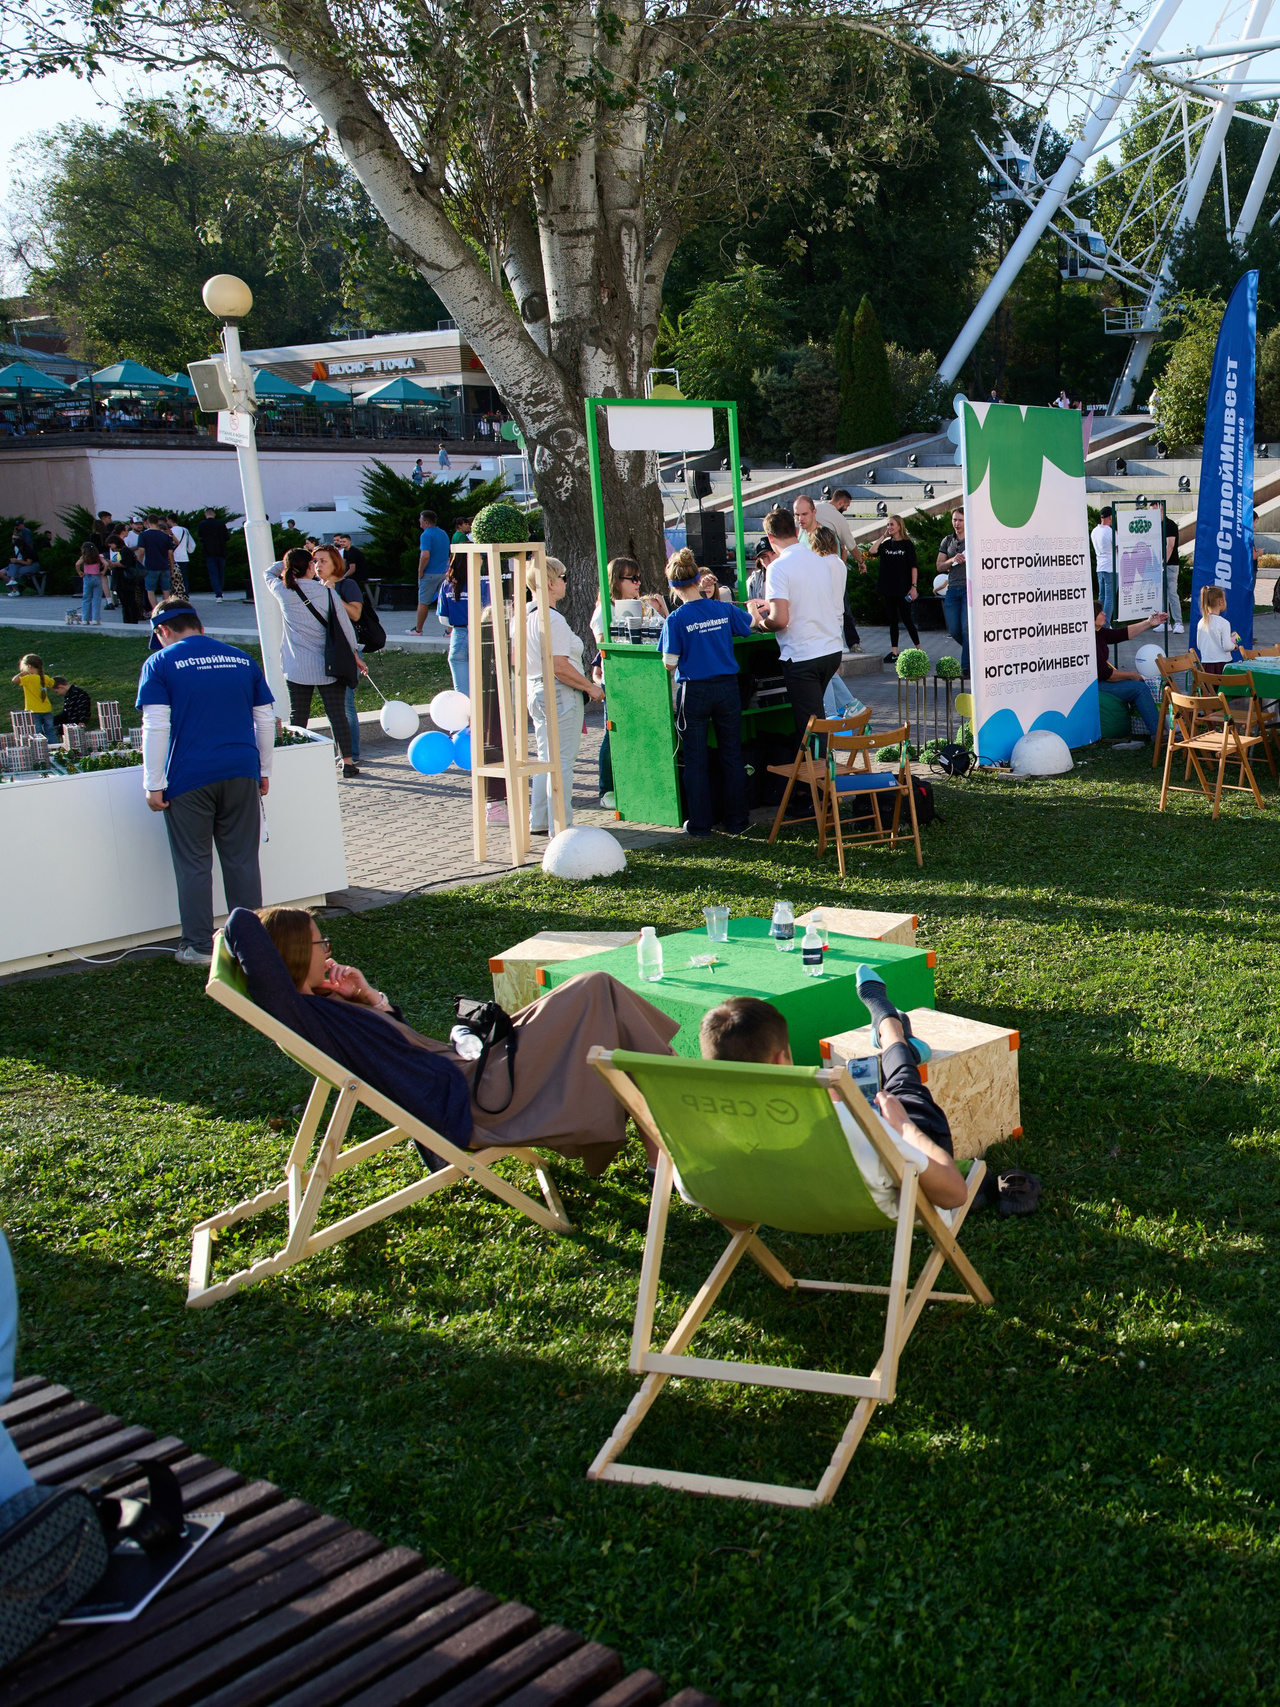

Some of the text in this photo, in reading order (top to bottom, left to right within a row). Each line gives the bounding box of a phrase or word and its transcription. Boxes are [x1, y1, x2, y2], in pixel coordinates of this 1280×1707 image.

[381, 357, 415, 371] ТОЧКА
[1237, 416, 1245, 488] КОМПАНИЙ
[980, 534, 1085, 552] ЮГСТРОЙИНВЕСТ
[981, 552, 1085, 570] ЮГСТРОЙИНВЕСТ
[982, 569, 1087, 589] ЮГСТРОЙИНВЕСТ
[982, 588, 1087, 606] ЮГСТРОЙИНВЕСТ
[983, 604, 1088, 625] ЮГСТРОЙИНВЕСТ
[983, 621, 1089, 643] ЮГСТРОЙИНВЕСТ
[984, 637, 1090, 662] ЮГСТРОЙИНВЕСТ
[985, 654, 1090, 679] ЮГСТРОЙИНВЕСТ
[985, 670, 1091, 697] ЮГСТРОЙИНВЕСТ
